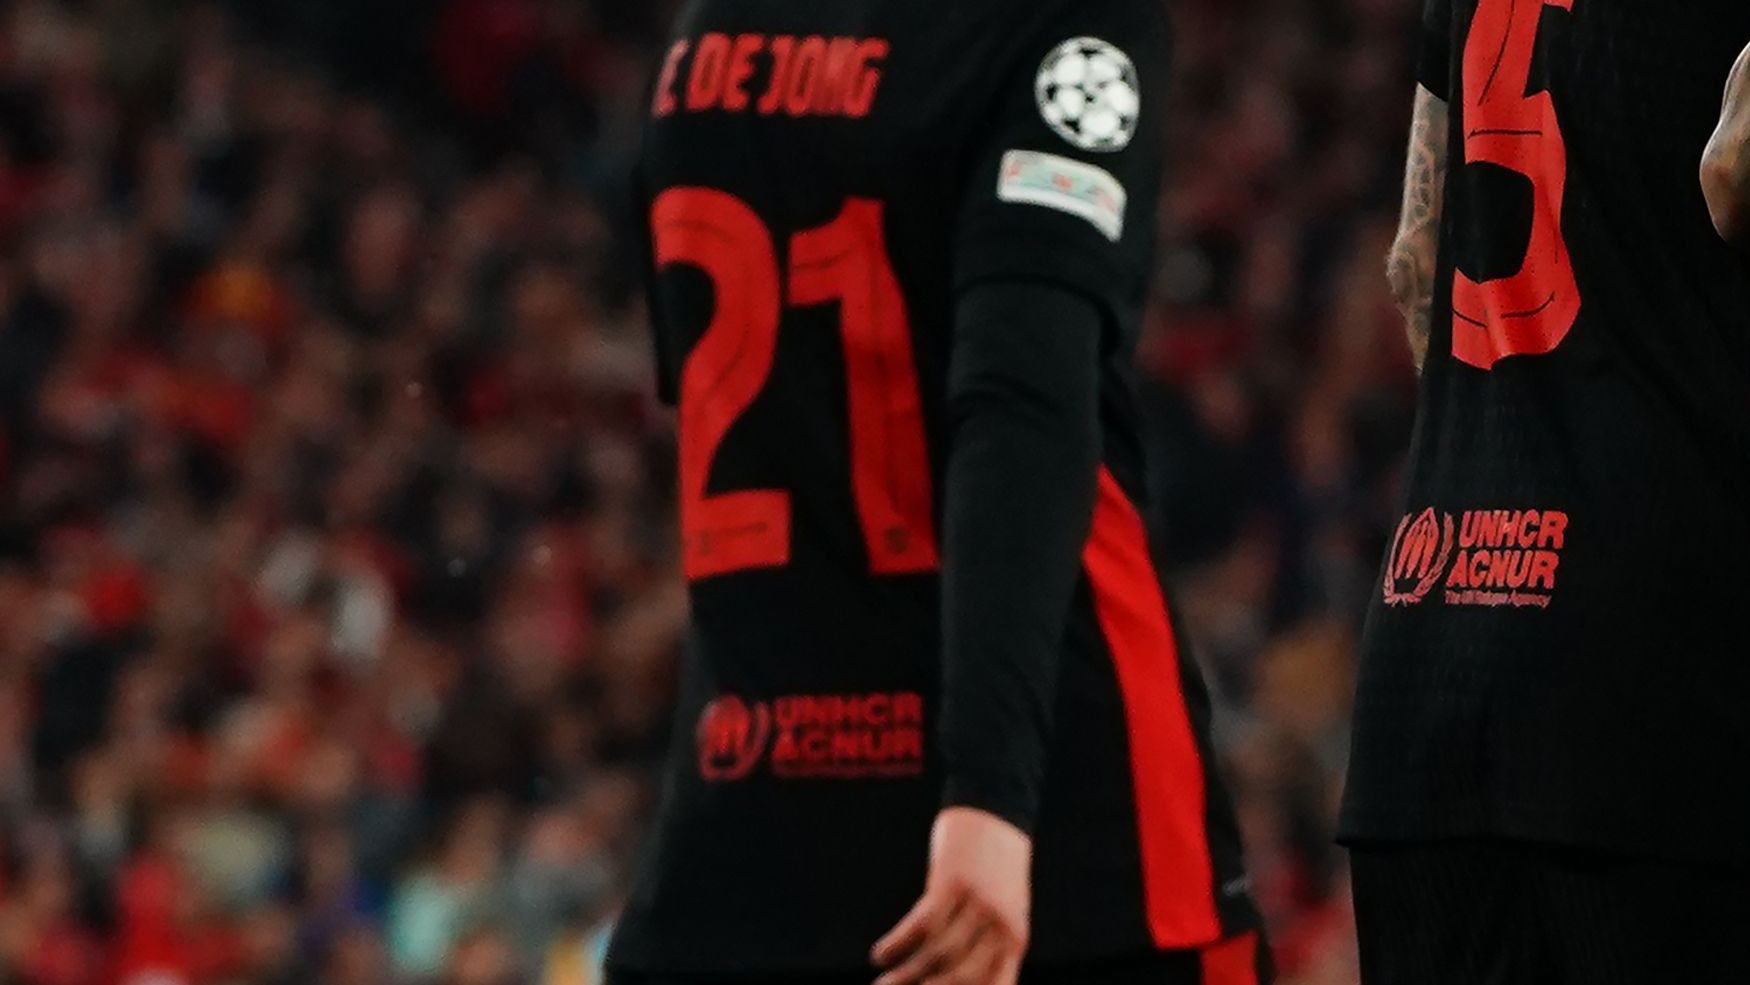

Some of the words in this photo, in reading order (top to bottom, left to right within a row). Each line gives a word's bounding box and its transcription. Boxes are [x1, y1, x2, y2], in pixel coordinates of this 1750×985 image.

[686, 32, 765, 111] DE
[757, 34, 889, 116] JONG
[651, 185, 941, 582] 21
[1458, 508, 1569, 549] UNHCR
[1445, 549, 1560, 590] ACNUR
